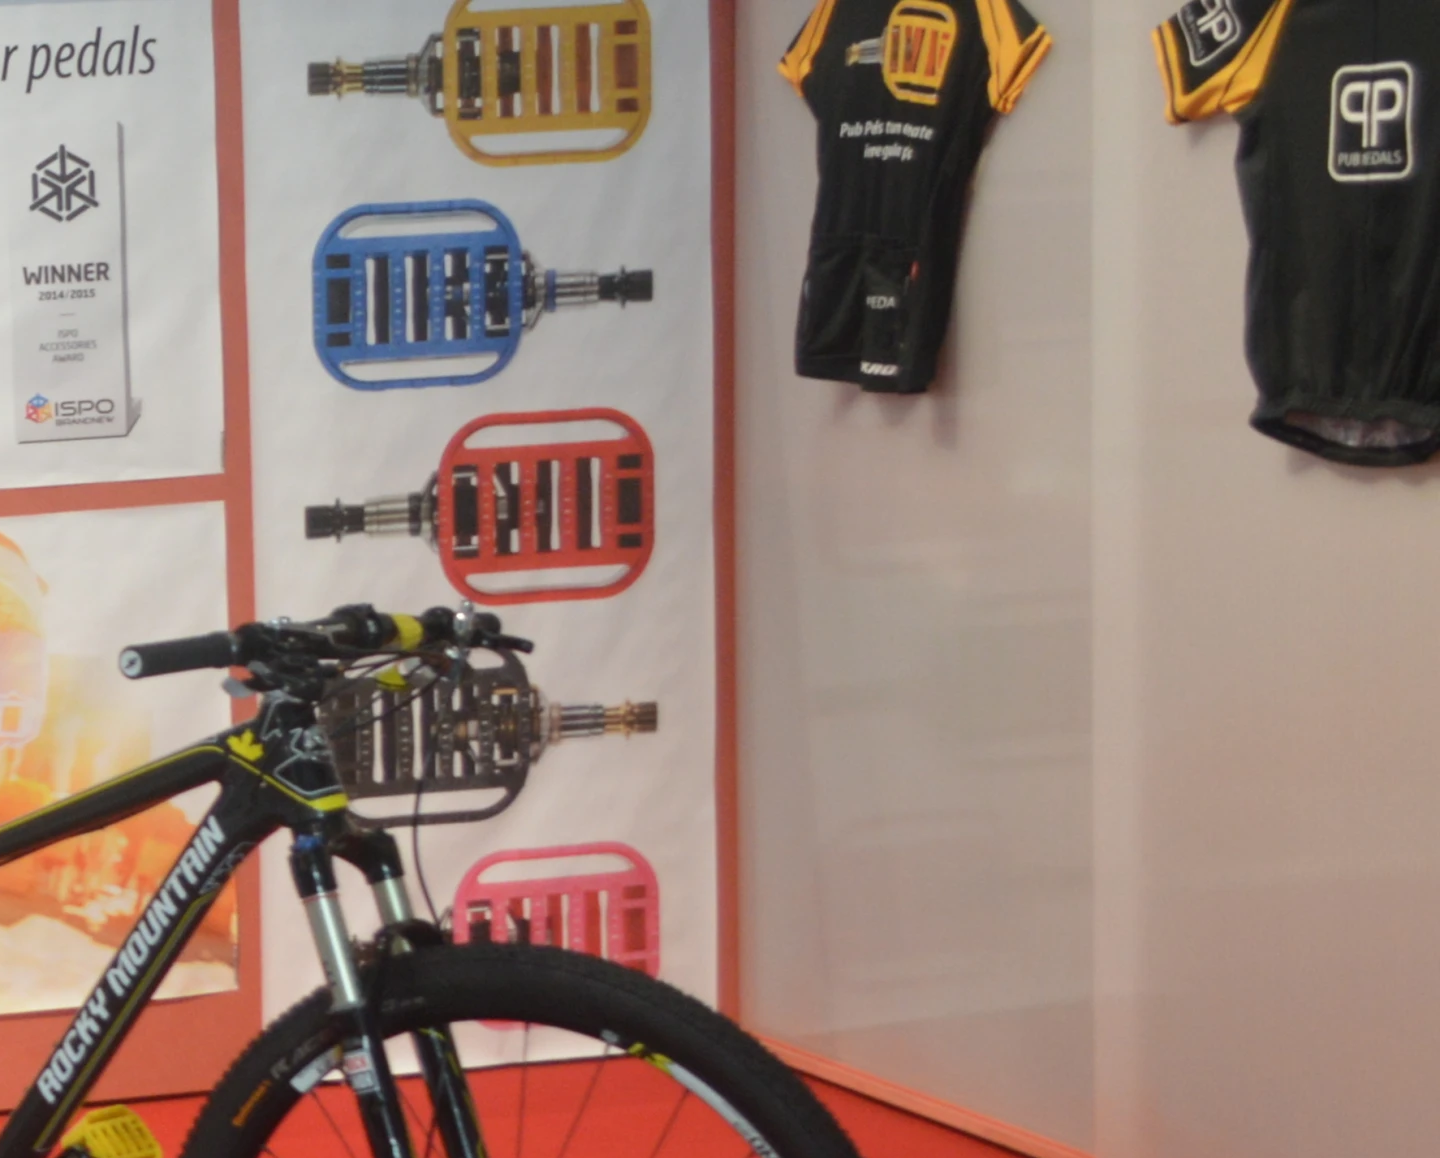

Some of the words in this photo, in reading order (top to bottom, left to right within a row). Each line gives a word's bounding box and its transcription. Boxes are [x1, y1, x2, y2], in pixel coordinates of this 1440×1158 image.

[25, 25, 157, 93] pedals
[22, 261, 110, 286] WINNER
[38, 288, 96, 302] 2014/2015
[38, 339, 97, 352] ACCESSORIES
[53, 398, 115, 417] ISPO
[36, 987, 111, 1105] ROCKY
[105, 814, 226, 998] MOUNTAIN
